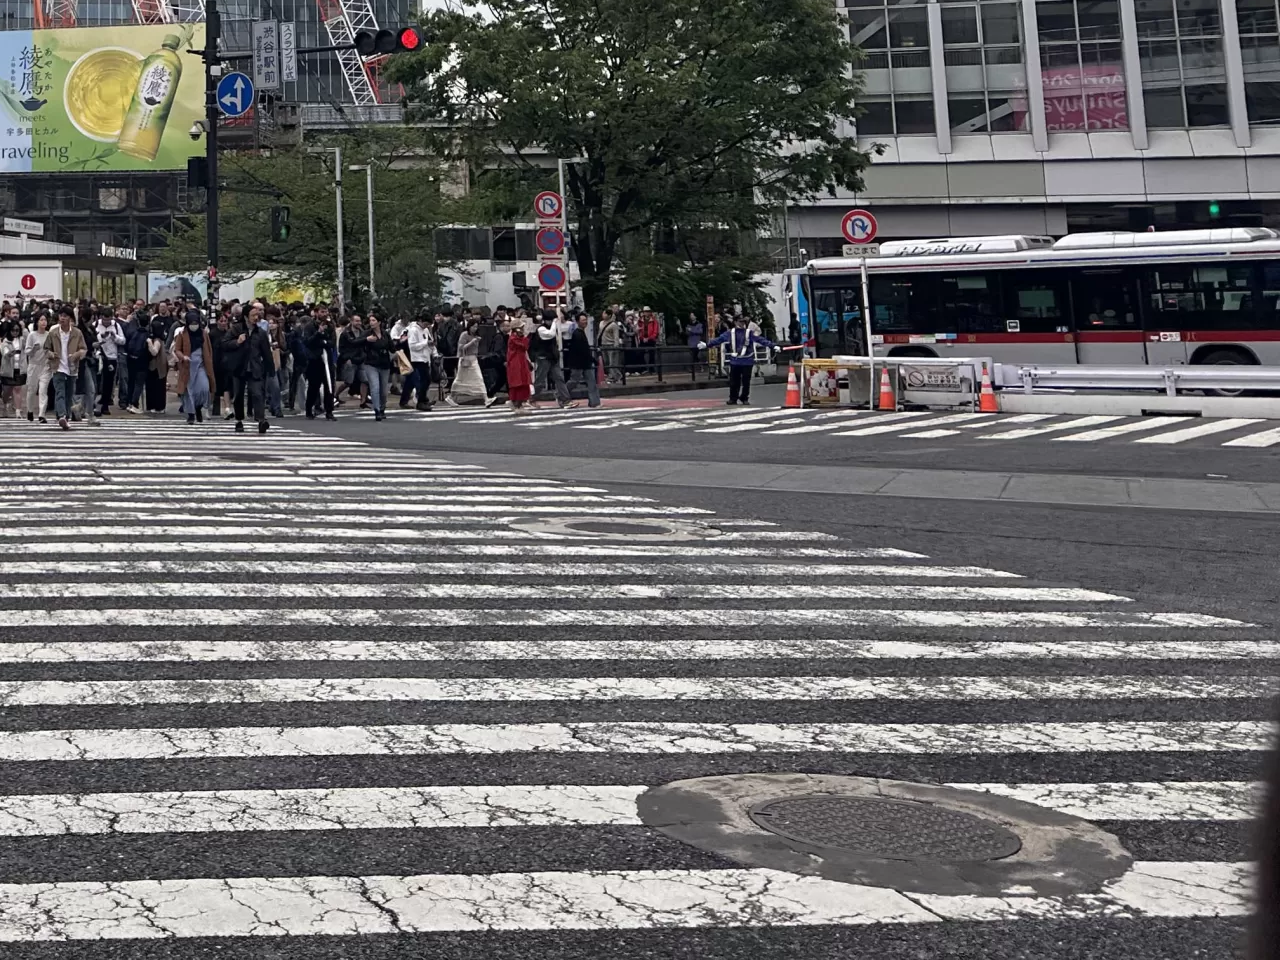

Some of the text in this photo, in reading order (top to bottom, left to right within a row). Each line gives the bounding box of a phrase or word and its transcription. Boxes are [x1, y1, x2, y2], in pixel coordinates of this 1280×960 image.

[263, 25, 276, 84] 渋谷駅前
[283, 24, 295, 80] スクランブル式
[18, 44, 45, 96] 綾鷹
[6, 127, 59, 137] 宇多田ヒカル
[19, 114, 47, 123] meets
[845, 246, 878, 256] ここまで
